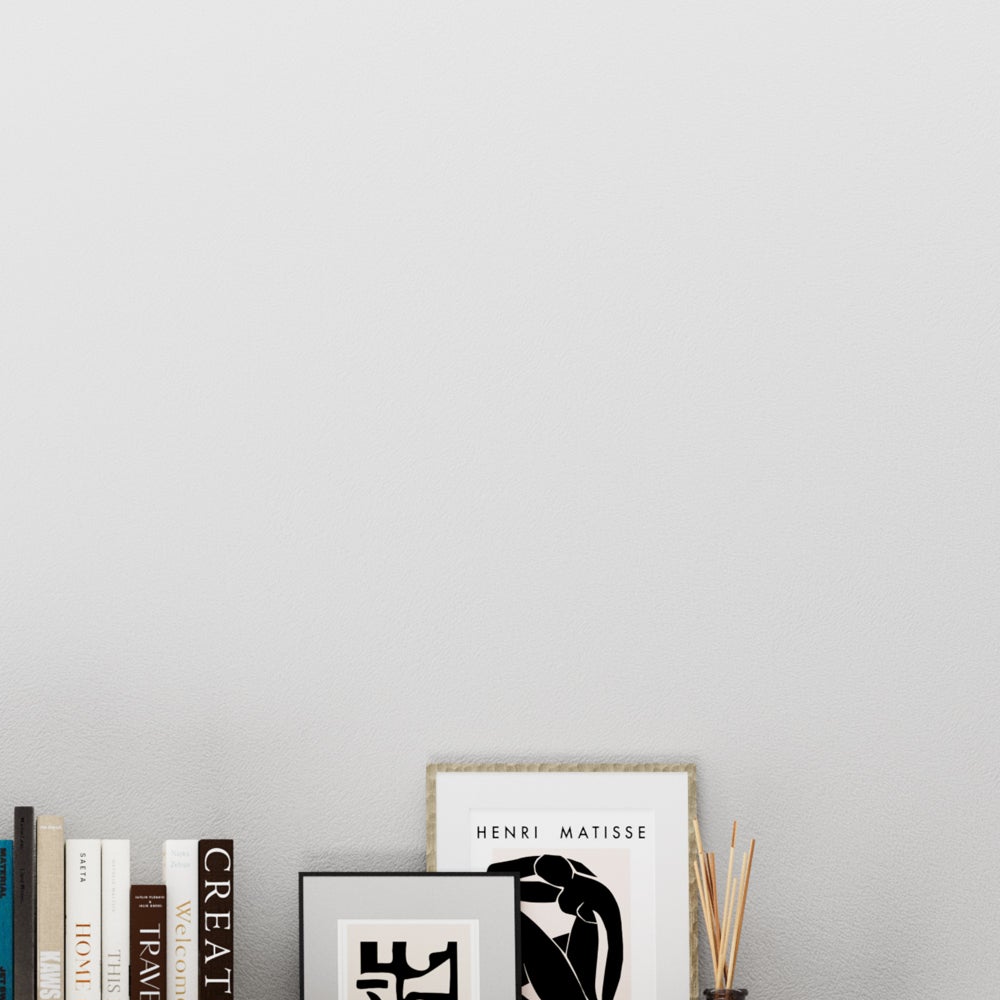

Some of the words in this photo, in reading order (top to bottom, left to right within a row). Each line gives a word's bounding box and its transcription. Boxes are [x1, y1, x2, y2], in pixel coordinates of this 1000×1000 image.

[477, 826, 538, 839] HENRI
[560, 826, 646, 839] MATISSE
[40, 951, 61, 1000] KAWS
[75, 923, 91, 991] HOME
[107, 949, 121, 993] THIS
